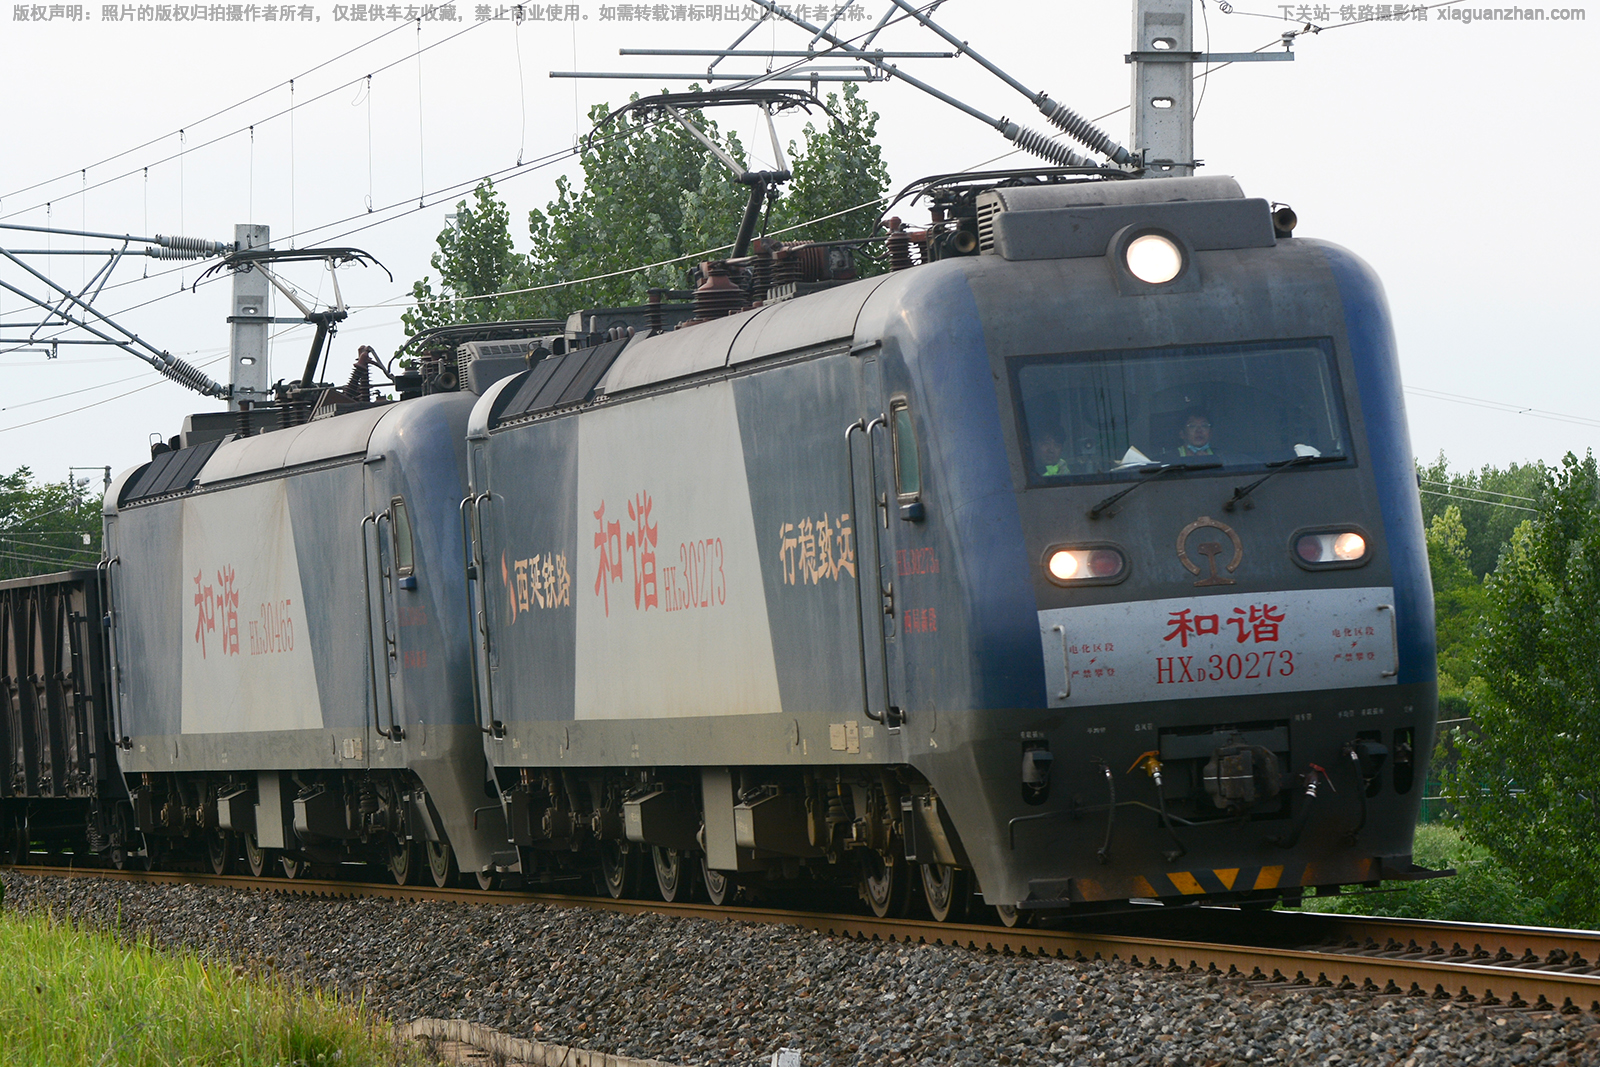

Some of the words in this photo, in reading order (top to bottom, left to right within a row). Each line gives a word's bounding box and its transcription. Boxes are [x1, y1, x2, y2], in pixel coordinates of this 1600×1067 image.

[514, 549, 571, 613] 西延铁路
[593, 489, 659, 618] 和谐
[779, 511, 855, 586] 行稳致远
[193, 563, 240, 660] 和谐
[1163, 603, 1286, 648] 和谐
[1156, 650, 1295, 684] HXD30273
